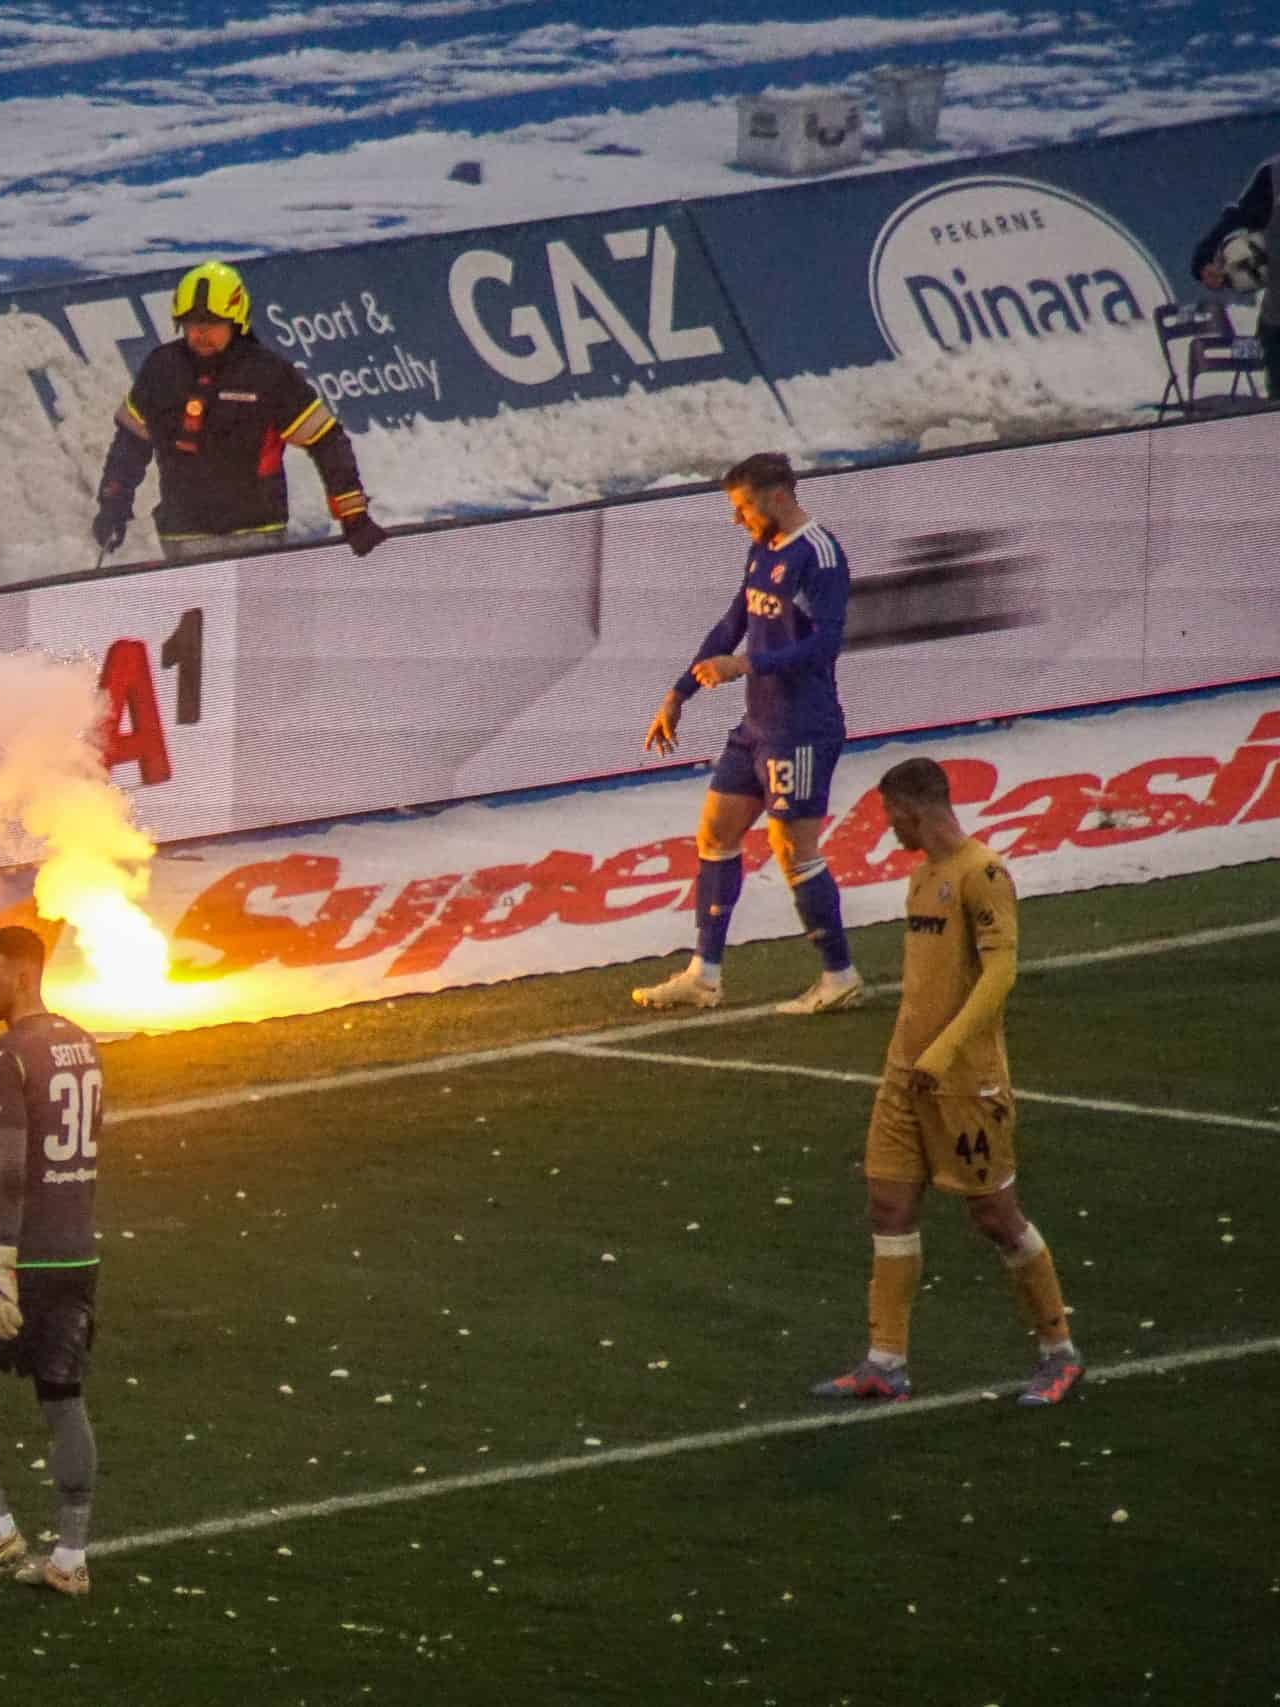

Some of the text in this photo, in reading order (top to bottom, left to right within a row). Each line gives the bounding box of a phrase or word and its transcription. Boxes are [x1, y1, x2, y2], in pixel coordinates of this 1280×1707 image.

[929, 208, 1046, 246] PEKARNE
[267, 291, 396, 358] Sport &
[448, 224, 724, 385] GAZ
[903, 267, 1145, 352] Dinara
[98, 606, 204, 786] A1
[766, 758, 795, 795] 13
[43, 1068, 102, 1161] 30
[954, 1129, 992, 1165] 44
